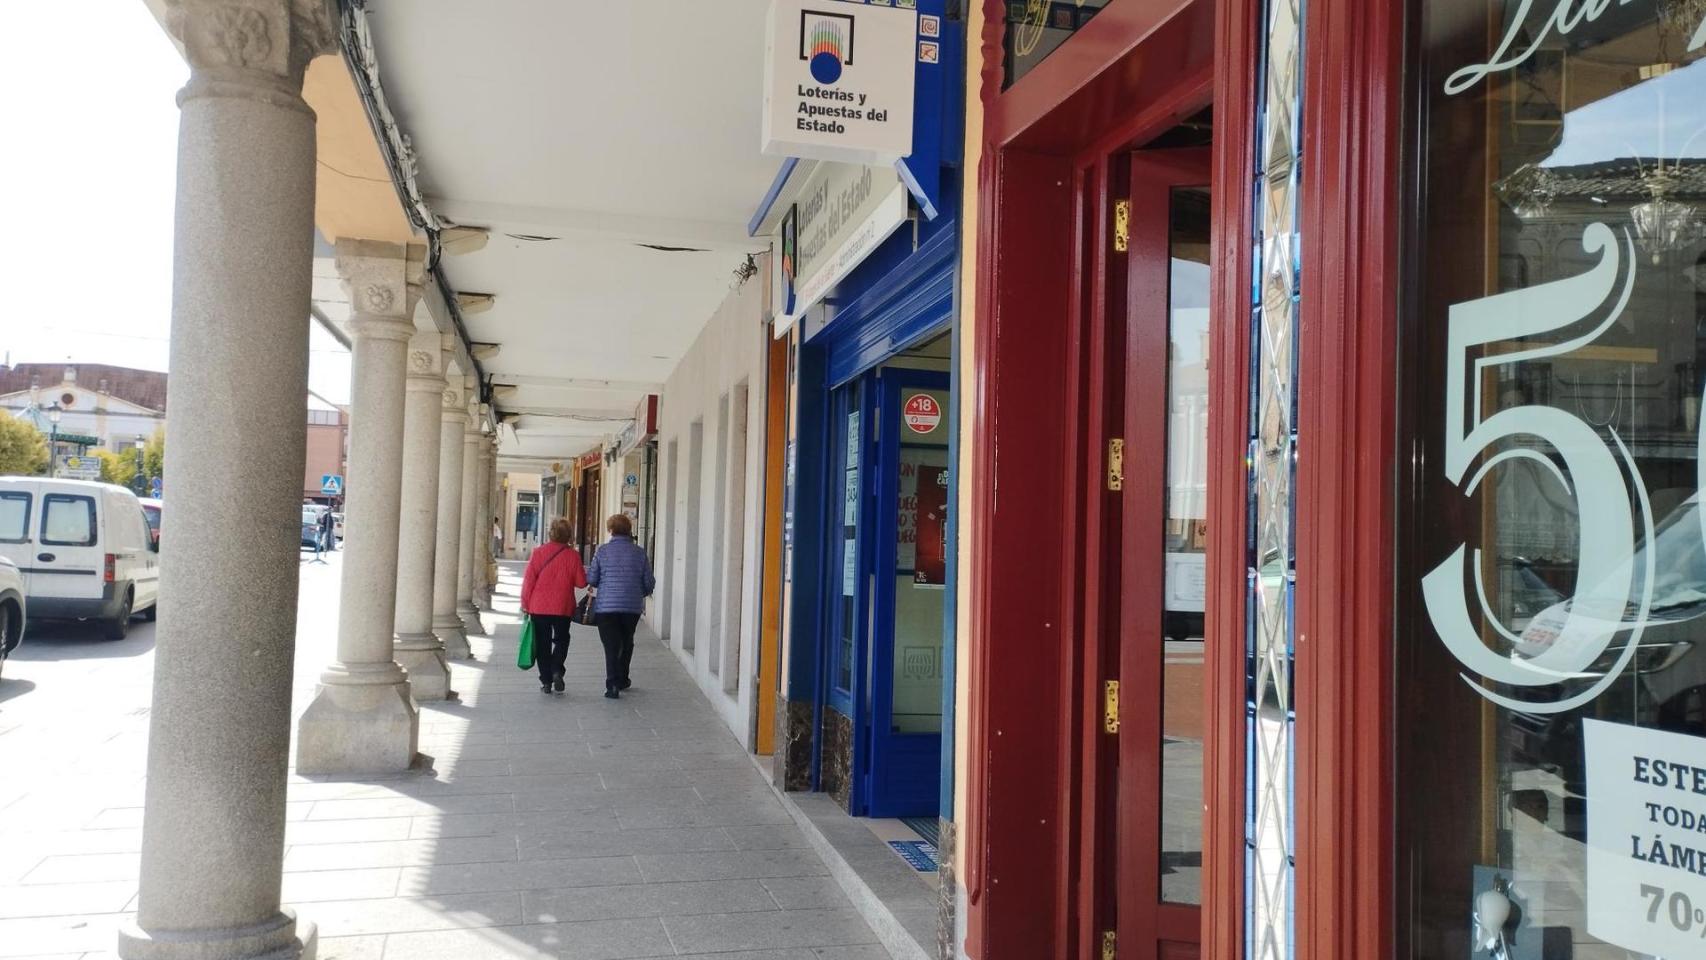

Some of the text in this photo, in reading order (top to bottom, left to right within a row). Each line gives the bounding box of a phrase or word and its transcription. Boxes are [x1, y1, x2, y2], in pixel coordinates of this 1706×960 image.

[797, 84, 867, 106] Loterías y
[797, 101, 888, 122] Apuestas del
[796, 117, 845, 134] Estado
[828, 195, 840, 240] del
[841, 164, 872, 225] Estado
[911, 398, 932, 411] +18
[1422, 222, 1706, 713] 5
[1633, 756, 1706, 796] ESTE
